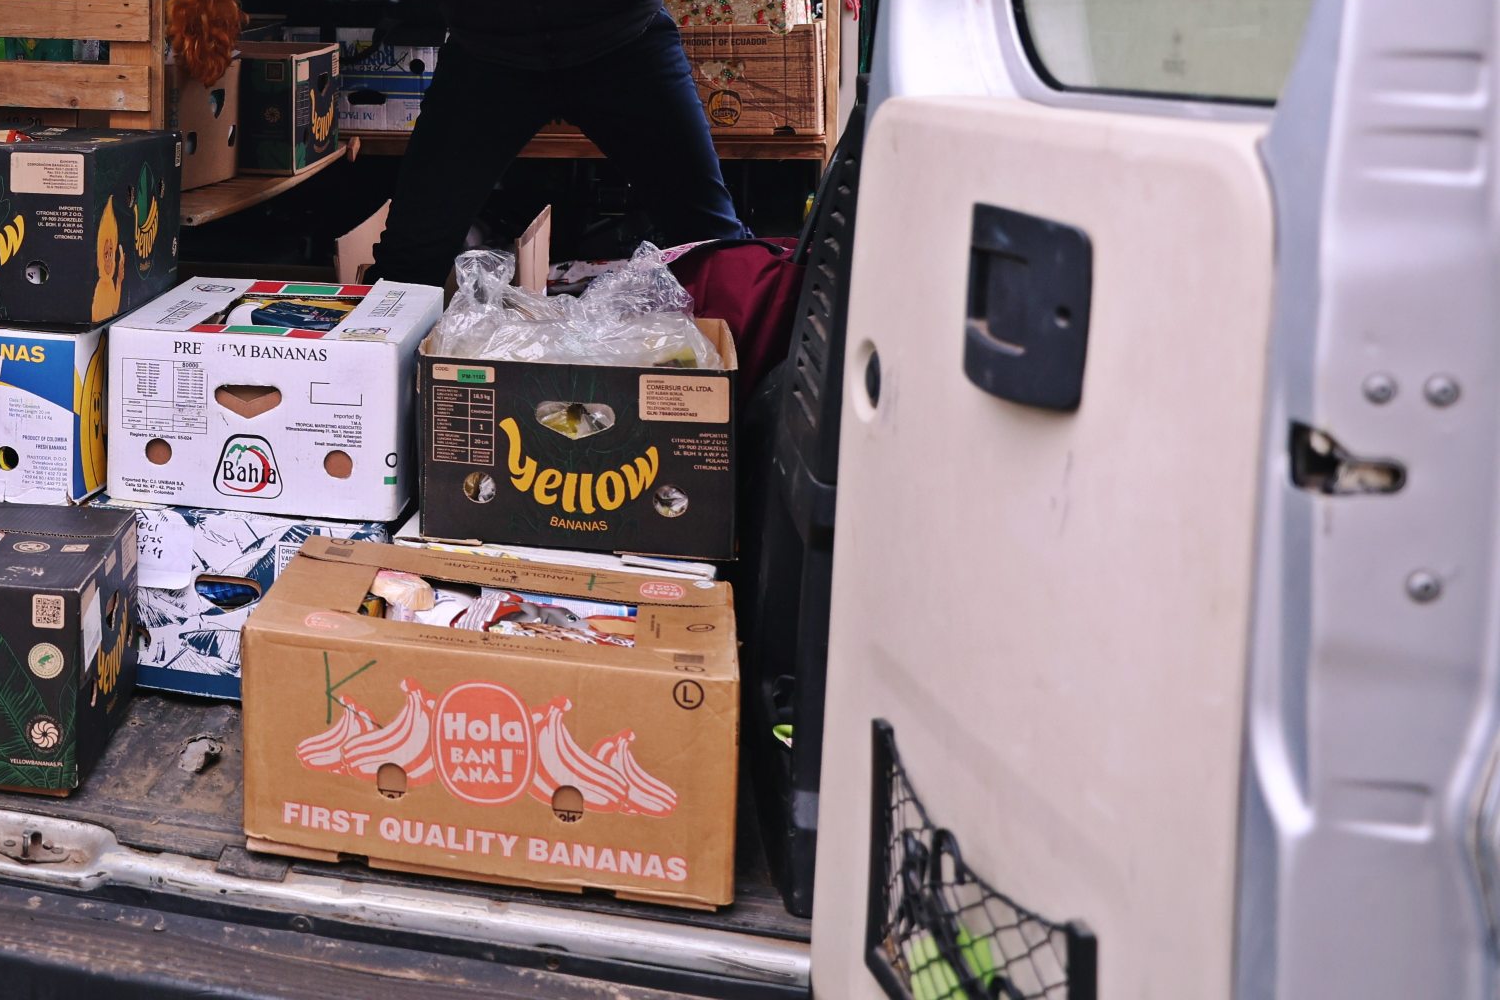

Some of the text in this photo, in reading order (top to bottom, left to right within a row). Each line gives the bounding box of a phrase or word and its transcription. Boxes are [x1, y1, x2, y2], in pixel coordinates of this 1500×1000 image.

[681, 37, 767, 46] PRODUCT OF ECUADOR
[250, 344, 328, 362] BANANAS
[121, 476, 142, 484] Exported
[549, 516, 608, 532] BANANAS
[281, 548, 298, 556] ORIG
[443, 562, 575, 582] HANDLE WITH CARE
[323, 651, 383, 728] K
[443, 712, 524, 743] Hola
[9, 757, 64, 767] YELLOWBANANAS.PL
[450, 747, 496, 765] BAN
[281, 802, 688, 883] FIRST QUALITY BANANAS
